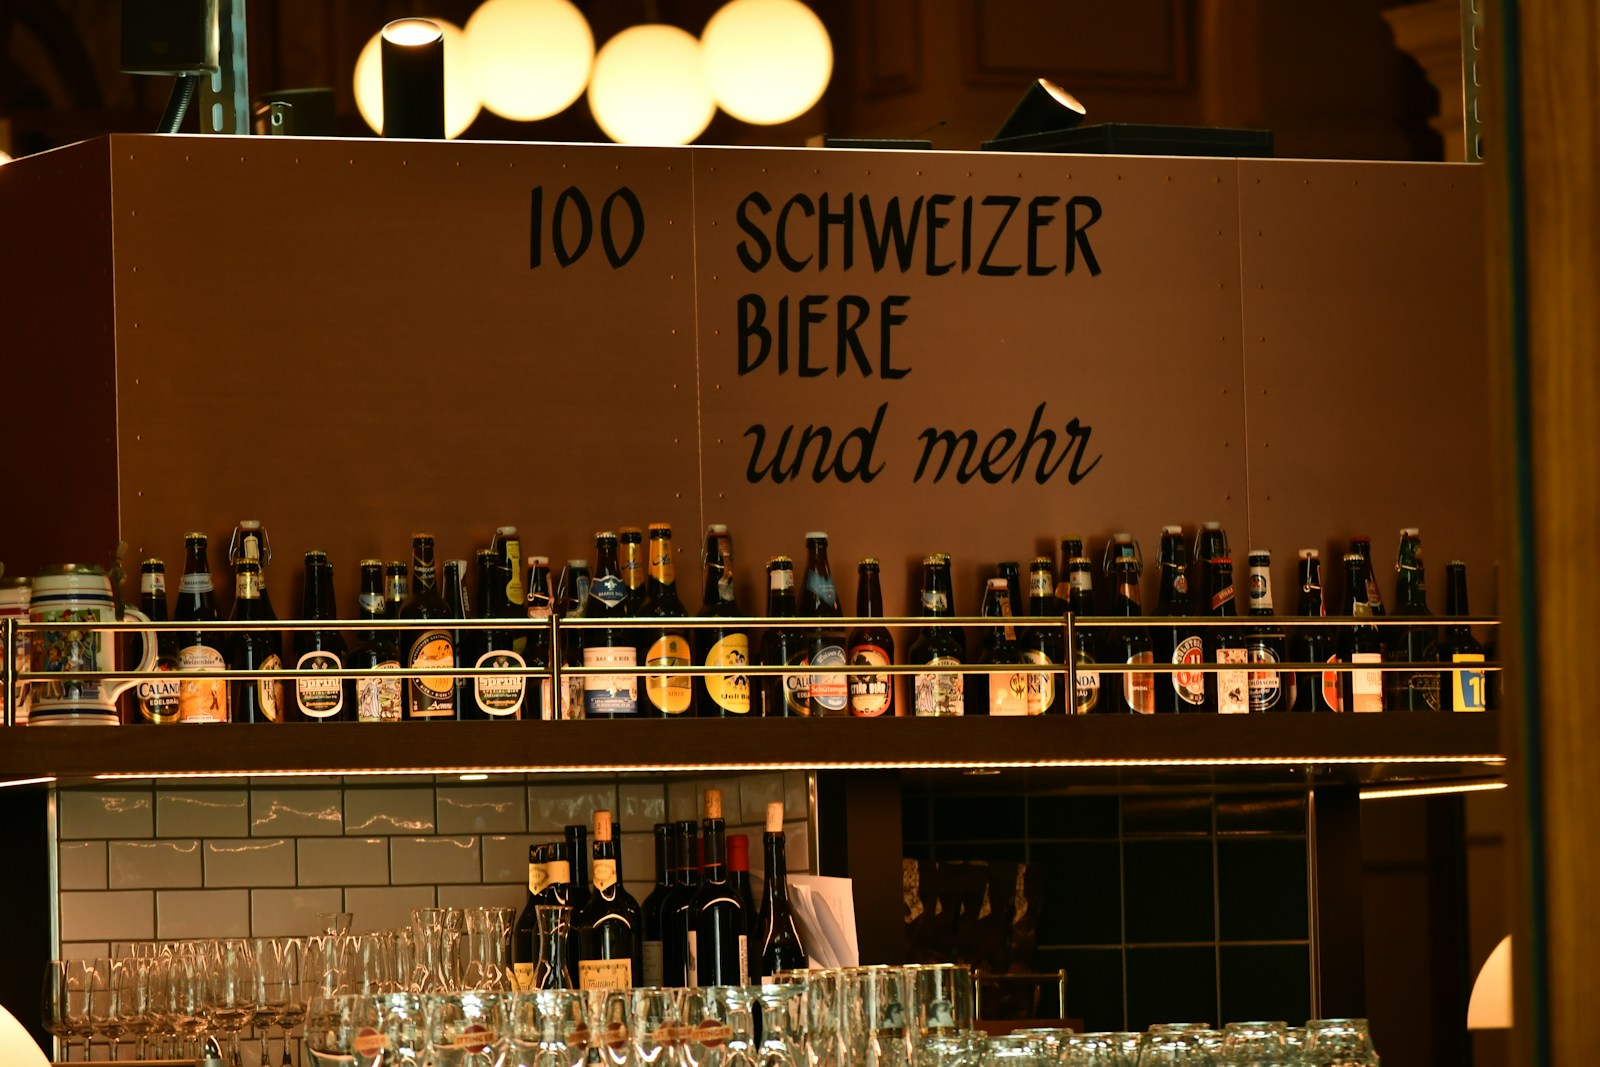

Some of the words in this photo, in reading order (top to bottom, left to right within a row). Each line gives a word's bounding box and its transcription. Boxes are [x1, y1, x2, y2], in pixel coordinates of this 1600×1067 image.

[530, 185, 645, 270] 100
[736, 191, 1103, 278] SCHWEIZER
[737, 293, 912, 380] BIERE
[743, 401, 889, 485] und
[913, 401, 1103, 486] mehr
[139, 682, 181, 698] CALAND
